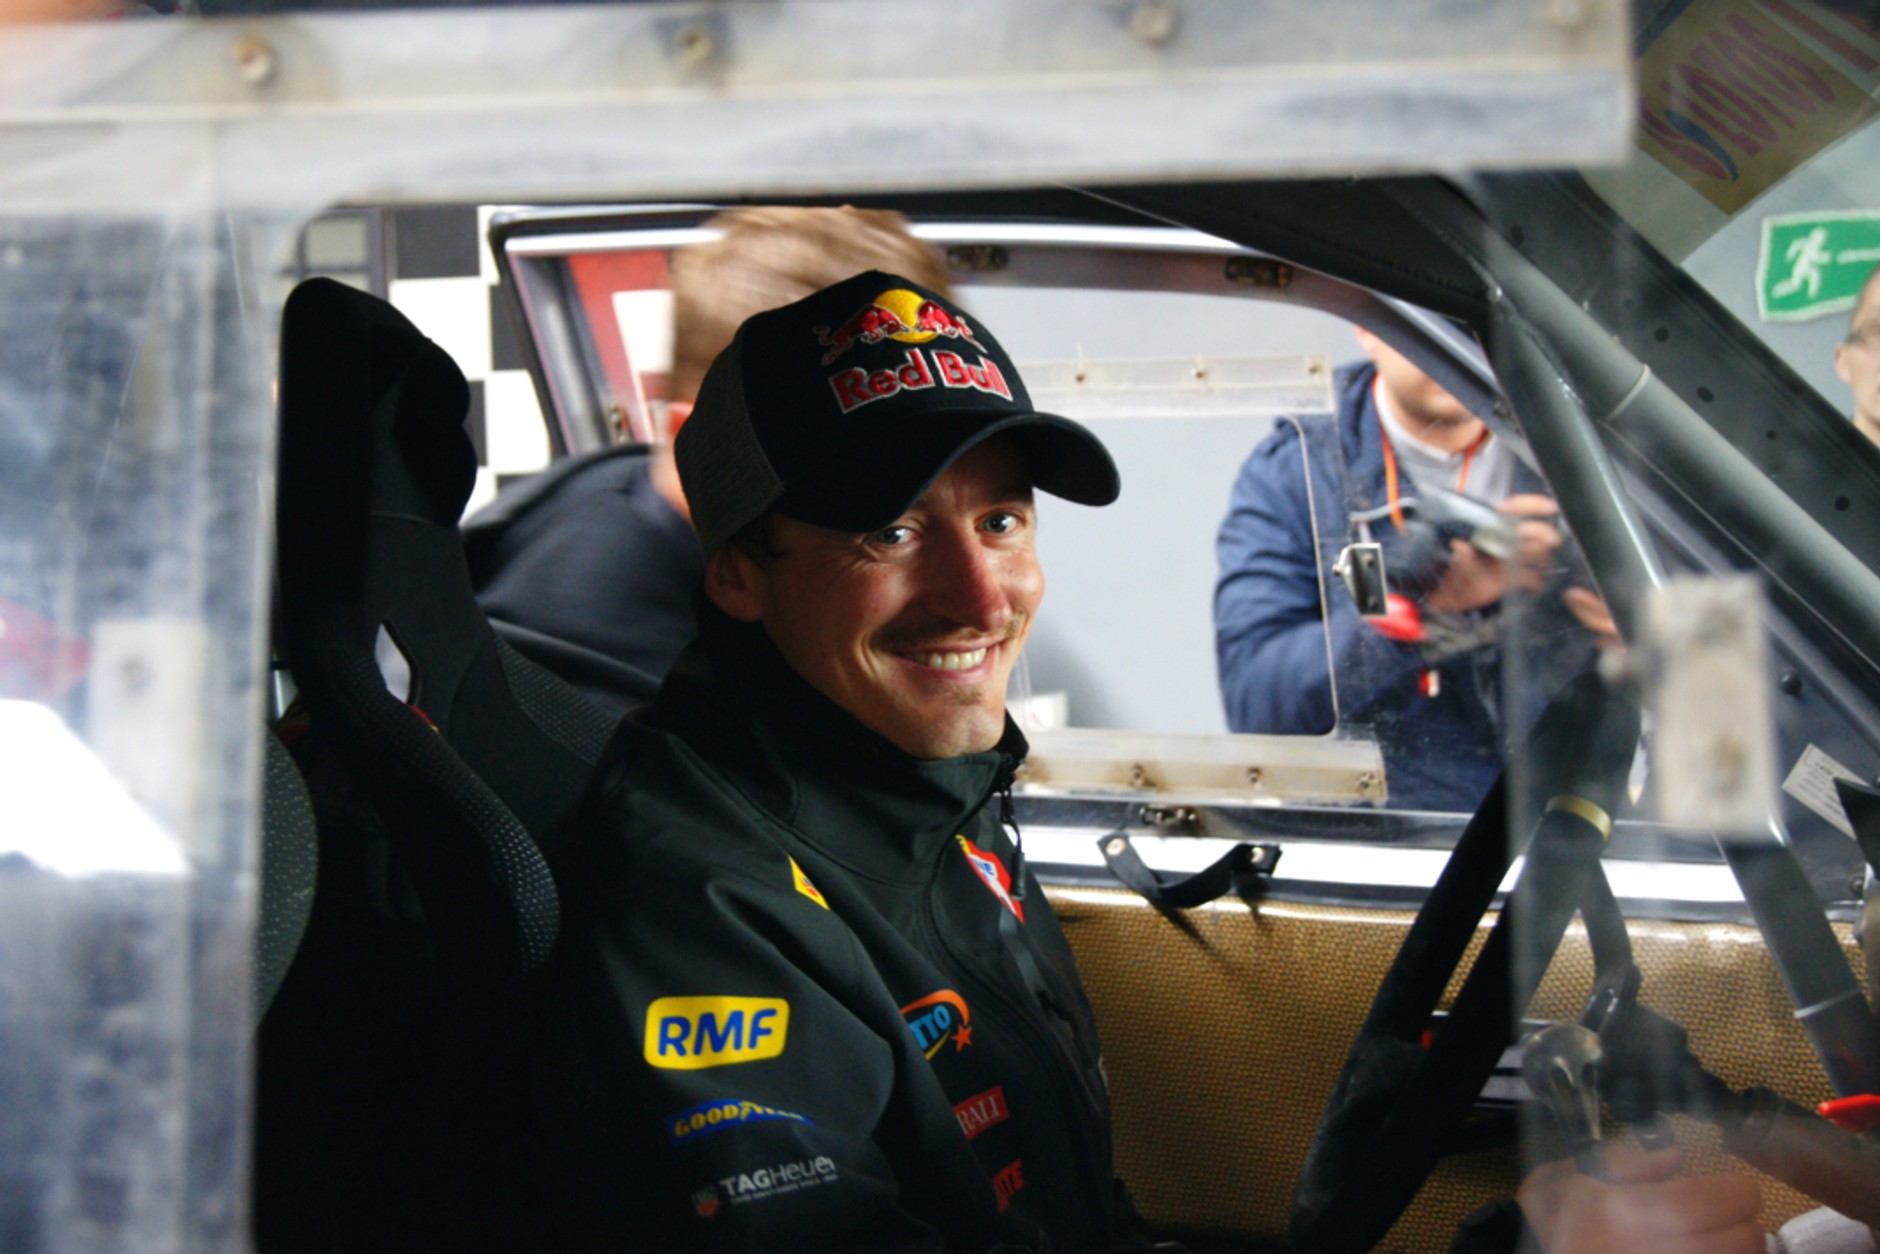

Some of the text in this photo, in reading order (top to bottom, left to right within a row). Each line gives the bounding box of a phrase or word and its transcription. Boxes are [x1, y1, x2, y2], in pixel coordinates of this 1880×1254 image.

[828, 347, 1013, 414] Red Bull
[658, 1008, 778, 1056] RMF
